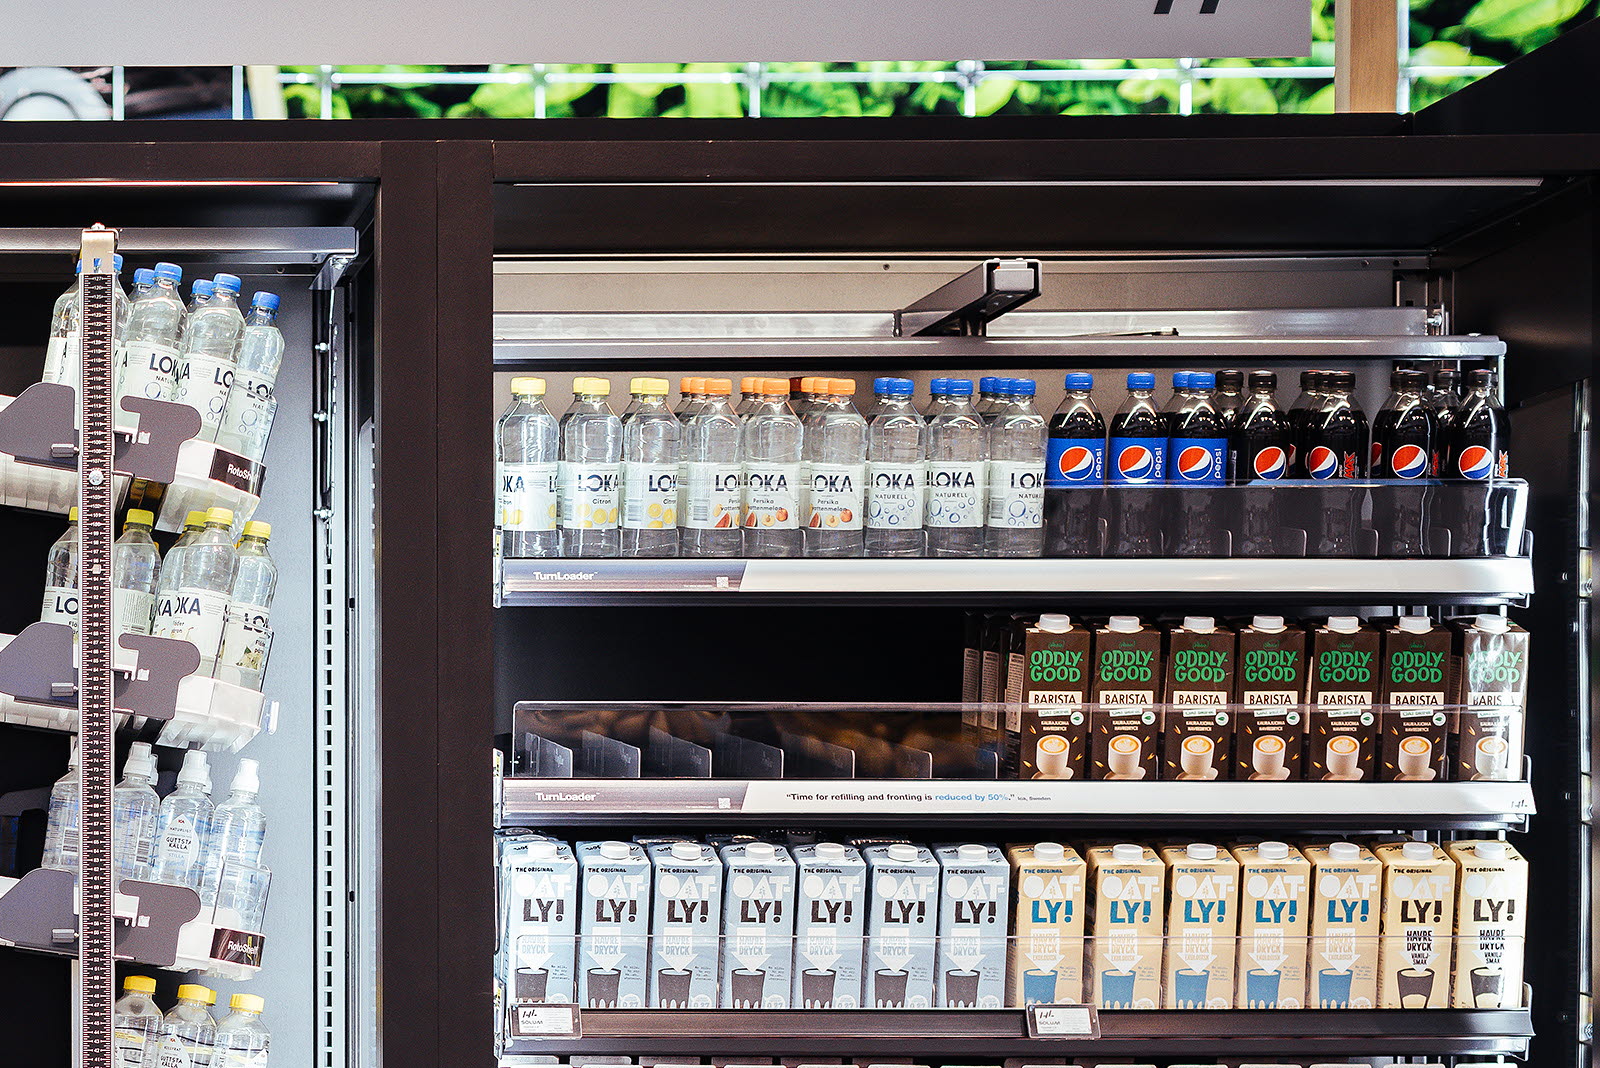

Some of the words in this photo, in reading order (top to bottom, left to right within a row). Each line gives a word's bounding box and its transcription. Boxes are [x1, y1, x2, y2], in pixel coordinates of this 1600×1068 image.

[1154, 447, 1162, 478] pepsi
[227, 463, 252, 481] RotoSh
[1029, 665, 1081, 682] GOOD
[1174, 665, 1226, 682] GOOD
[1390, 666, 1442, 683] GOOD
[1034, 694, 1076, 705] BARISTA
[1178, 694, 1221, 705] BARISTA
[1395, 695, 1439, 706] BARISTA
[816, 793, 828, 801] for
[831, 793, 865, 803] refilling
[867, 793, 884, 801] and
[887, 793, 923, 803] fronting
[924, 793, 933, 801] is
[935, 793, 972, 801] reduced
[975, 793, 985, 803] by
[523, 898, 564, 923] LY!
[740, 899, 782, 924] LY!
[1031, 899, 1073, 923] LY!
[1400, 899, 1443, 924] LY!
[1406, 942, 1432, 952] DRYCK
